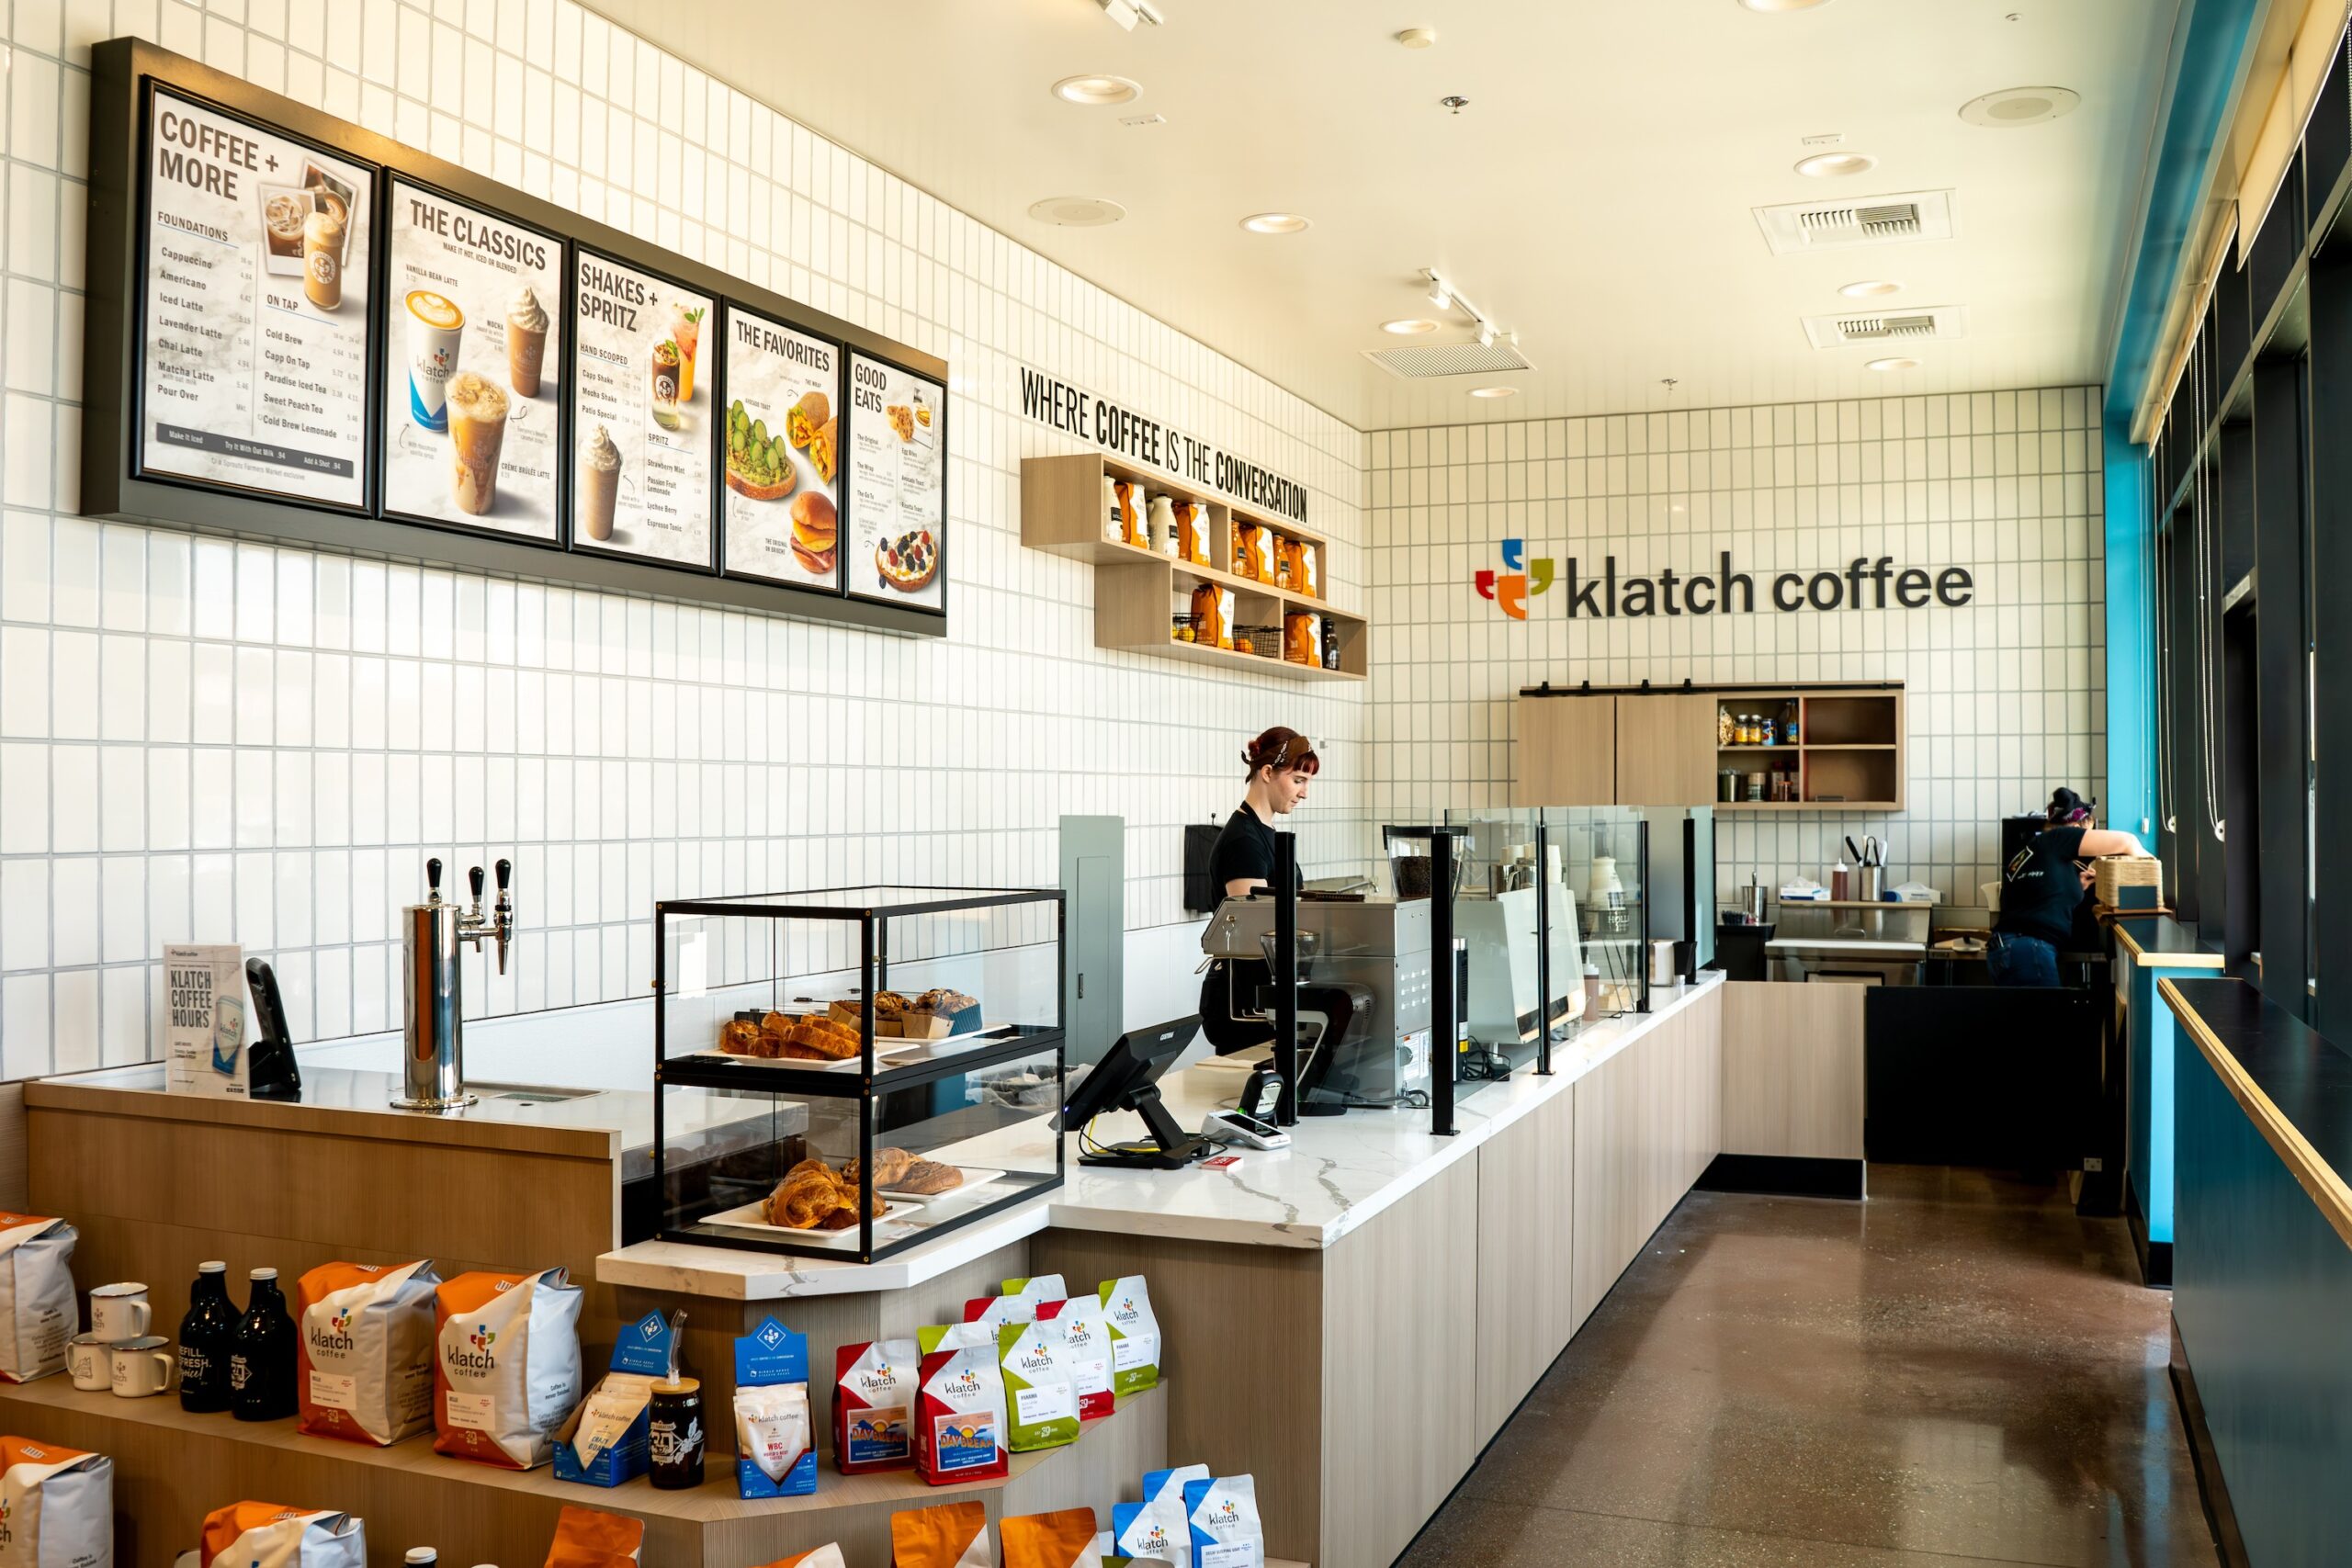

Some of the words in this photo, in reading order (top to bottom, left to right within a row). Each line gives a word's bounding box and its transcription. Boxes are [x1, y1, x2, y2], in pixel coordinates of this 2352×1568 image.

[160, 111, 258, 172] COFFEE
[160, 149, 238, 201] MORE
[158, 211, 228, 242] FOUNDATIONS
[410, 198, 448, 237] THE
[453, 216, 546, 271] CLASSICS
[162, 247, 212, 269] Cappuccino
[443, 242, 457, 254] MAKE
[458, 247, 463, 255] IT
[476, 254, 487, 265] ICED
[488, 258, 495, 266] OR
[496, 260, 516, 274] BLENDED
[160, 270, 207, 290] Americano
[405, 264, 427, 276] VANILLA
[429, 271, 442, 281] BEAN
[444, 276, 458, 287] LATTE
[581, 263, 644, 306] SHAKES
[160, 292, 178, 306] Iced
[181, 299, 204, 312] Latte
[267, 294, 279, 307] ON
[282, 299, 299, 311] TAP
[580, 292, 637, 333] SPRITZ
[159, 315, 198, 333] Lavender
[200, 326, 222, 340] Latte
[487, 320, 503, 331] MOCHA
[266, 328, 282, 340] Cold
[285, 333, 302, 345] Brew
[736, 320, 761, 348] THE
[764, 331, 829, 372] FAVORITES
[158, 338, 178, 352] Chai
[180, 344, 203, 357] Latte
[580, 343, 598, 355] HAND
[599, 349, 628, 365] SCOOPED
[265, 350, 284, 364] Capp
[287, 355, 296, 365] On
[298, 358, 310, 370] Tap
[416, 354, 449, 378] klatch
[158, 361, 190, 377] Matcha
[193, 369, 215, 382] Latte
[582, 369, 596, 380] Capp
[597, 374, 614, 385] Shake
[855, 363, 887, 391] GOOD
[157, 384, 177, 397] Pour
[180, 389, 198, 401] Over
[265, 371, 296, 387] Paradise
[299, 379, 313, 391] Iced
[315, 384, 327, 395] Tea
[264, 393, 286, 406] Sweet
[288, 399, 310, 412] Peach
[311, 404, 323, 414] Tea
[582, 387, 600, 399] Mocha
[601, 392, 617, 403] Shake
[855, 387, 882, 413] EATS
[582, 405, 595, 415] Patio
[597, 409, 616, 421] Special
[263, 415, 280, 426] Cold
[282, 419, 300, 430] Brew
[301, 423, 337, 438] Lemonade
[648, 434, 669, 446] SPRITZ
[1021, 367, 1090, 439] WHERE
[1096, 400, 1160, 466] COFFEE
[1166, 429, 1179, 472] IS
[1183, 436, 1210, 485] THE
[1216, 451, 1306, 523] CONVERSATION
[537, 470, 549, 479] LATTE
[648, 459, 673, 472] Strawberry
[674, 466, 684, 474] Mint
[648, 476, 665, 486] Passion
[666, 479, 676, 489] Fruit
[648, 485, 671, 496] Lemonade
[647, 502, 663, 512] Lychee
[664, 505, 677, 515] Berry
[647, 519, 669, 529] Espresso
[1567, 551, 1754, 617] klatch
[1774, 557, 1973, 612] coffee
[171, 970, 211, 989] KLATCH
[172, 989, 212, 1009] COFFEE
[173, 1009, 209, 1028] HOURS
[1114, 1309, 1138, 1322] klatch
[311, 1326, 353, 1350] klatch
[317, 1348, 345, 1359] coffee
[447, 1345, 494, 1369] klatch
[1021, 1355, 1053, 1369] klatch
[454, 1369, 486, 1378] coffee
[861, 1372, 896, 1389] klatch
[944, 1378, 980, 1394] klatch
[758, 1415, 778, 1423] klatch
[767, 1442, 783, 1450] WBC
[1209, 1512, 1239, 1526] klatch
[1137, 1537, 1168, 1551] klatch
